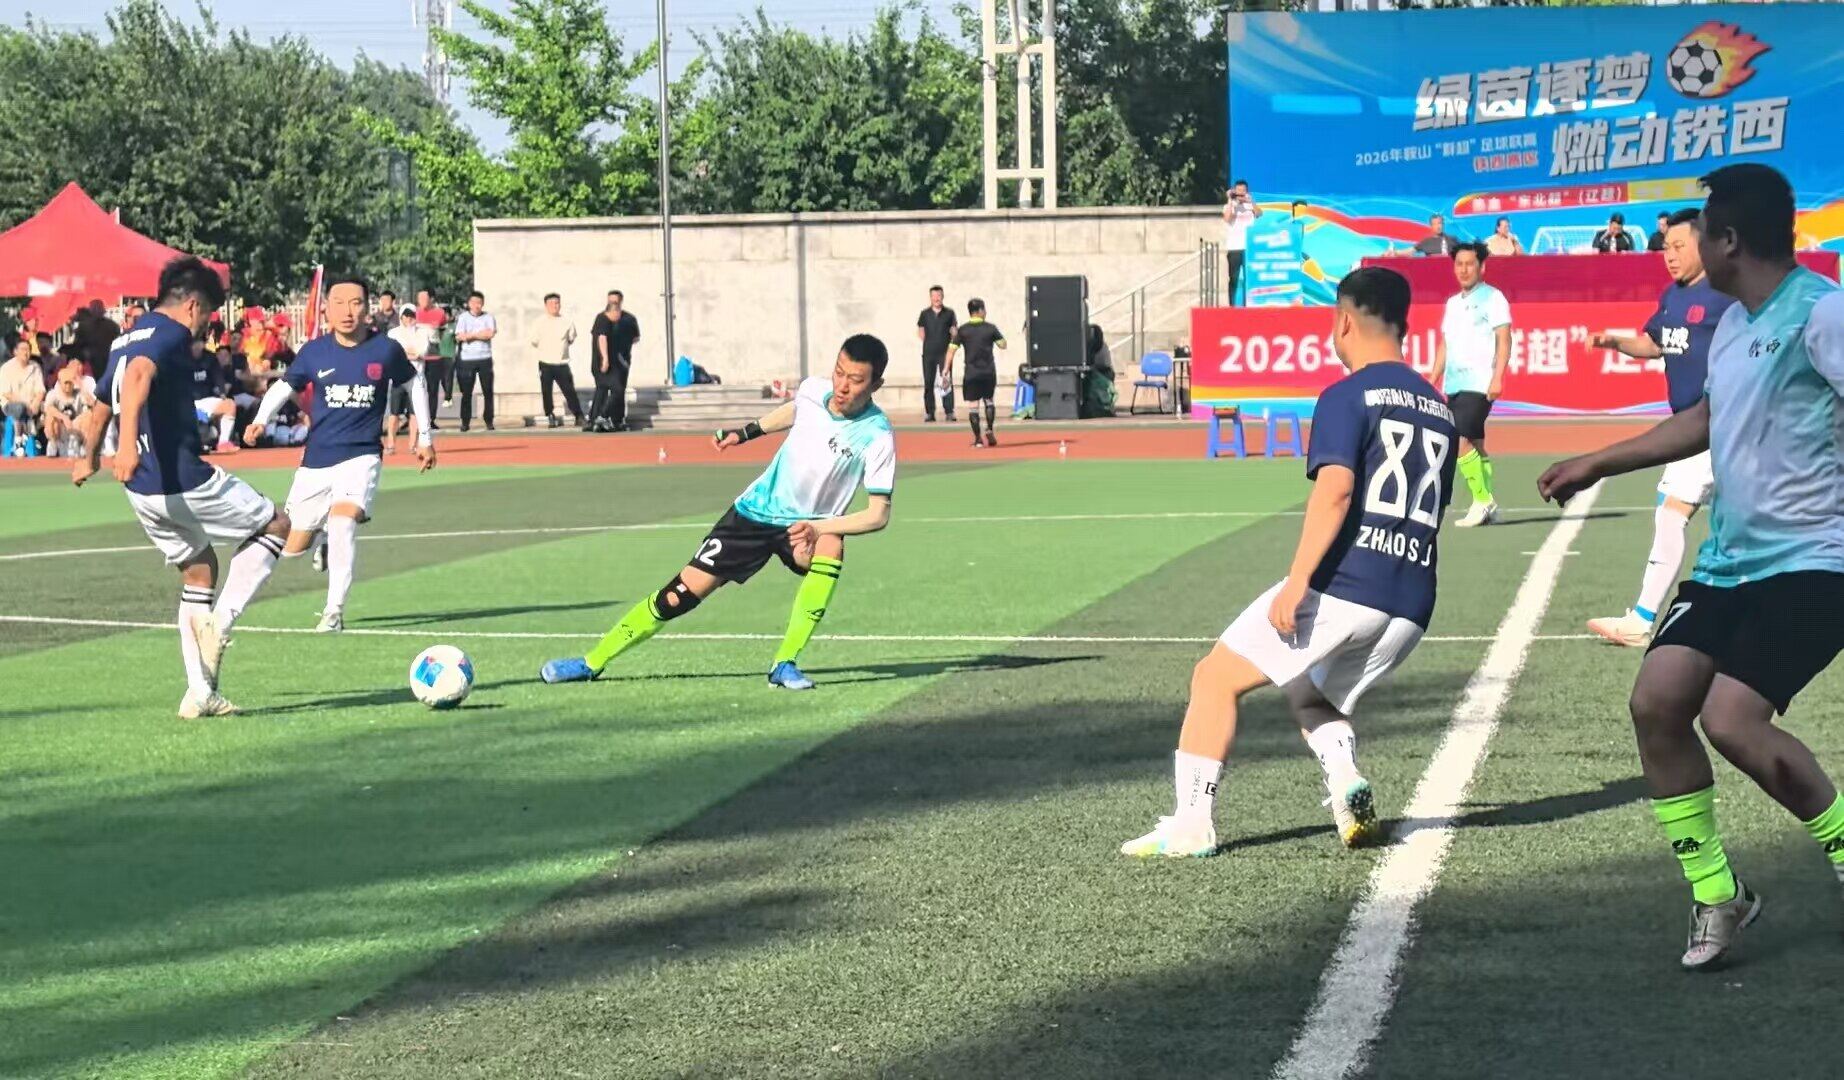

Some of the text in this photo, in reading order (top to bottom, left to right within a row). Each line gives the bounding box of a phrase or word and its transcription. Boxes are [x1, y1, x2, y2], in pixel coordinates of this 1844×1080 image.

[1413, 52, 1651, 132] 绿茵逐梦
[1549, 97, 1790, 176] 燃动铁西
[1365, 418, 1450, 529] 88
[694, 538, 722, 566] 12
